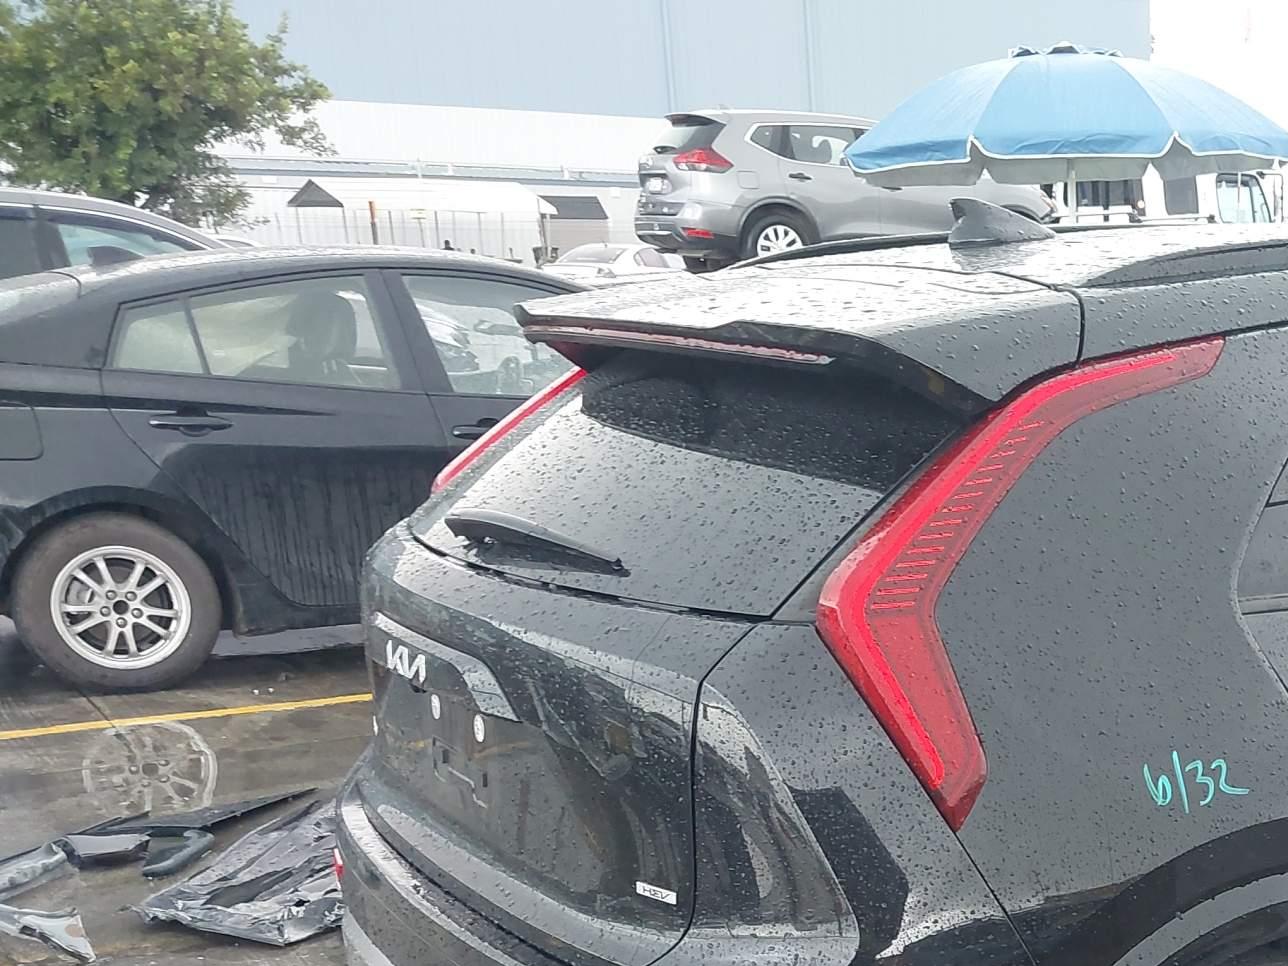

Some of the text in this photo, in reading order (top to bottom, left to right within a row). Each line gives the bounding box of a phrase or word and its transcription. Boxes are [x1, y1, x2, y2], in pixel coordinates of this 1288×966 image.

[386, 639, 427, 684] KIA
[1142, 750, 1250, 814] 6/32
[642, 886, 670, 899] HEV
